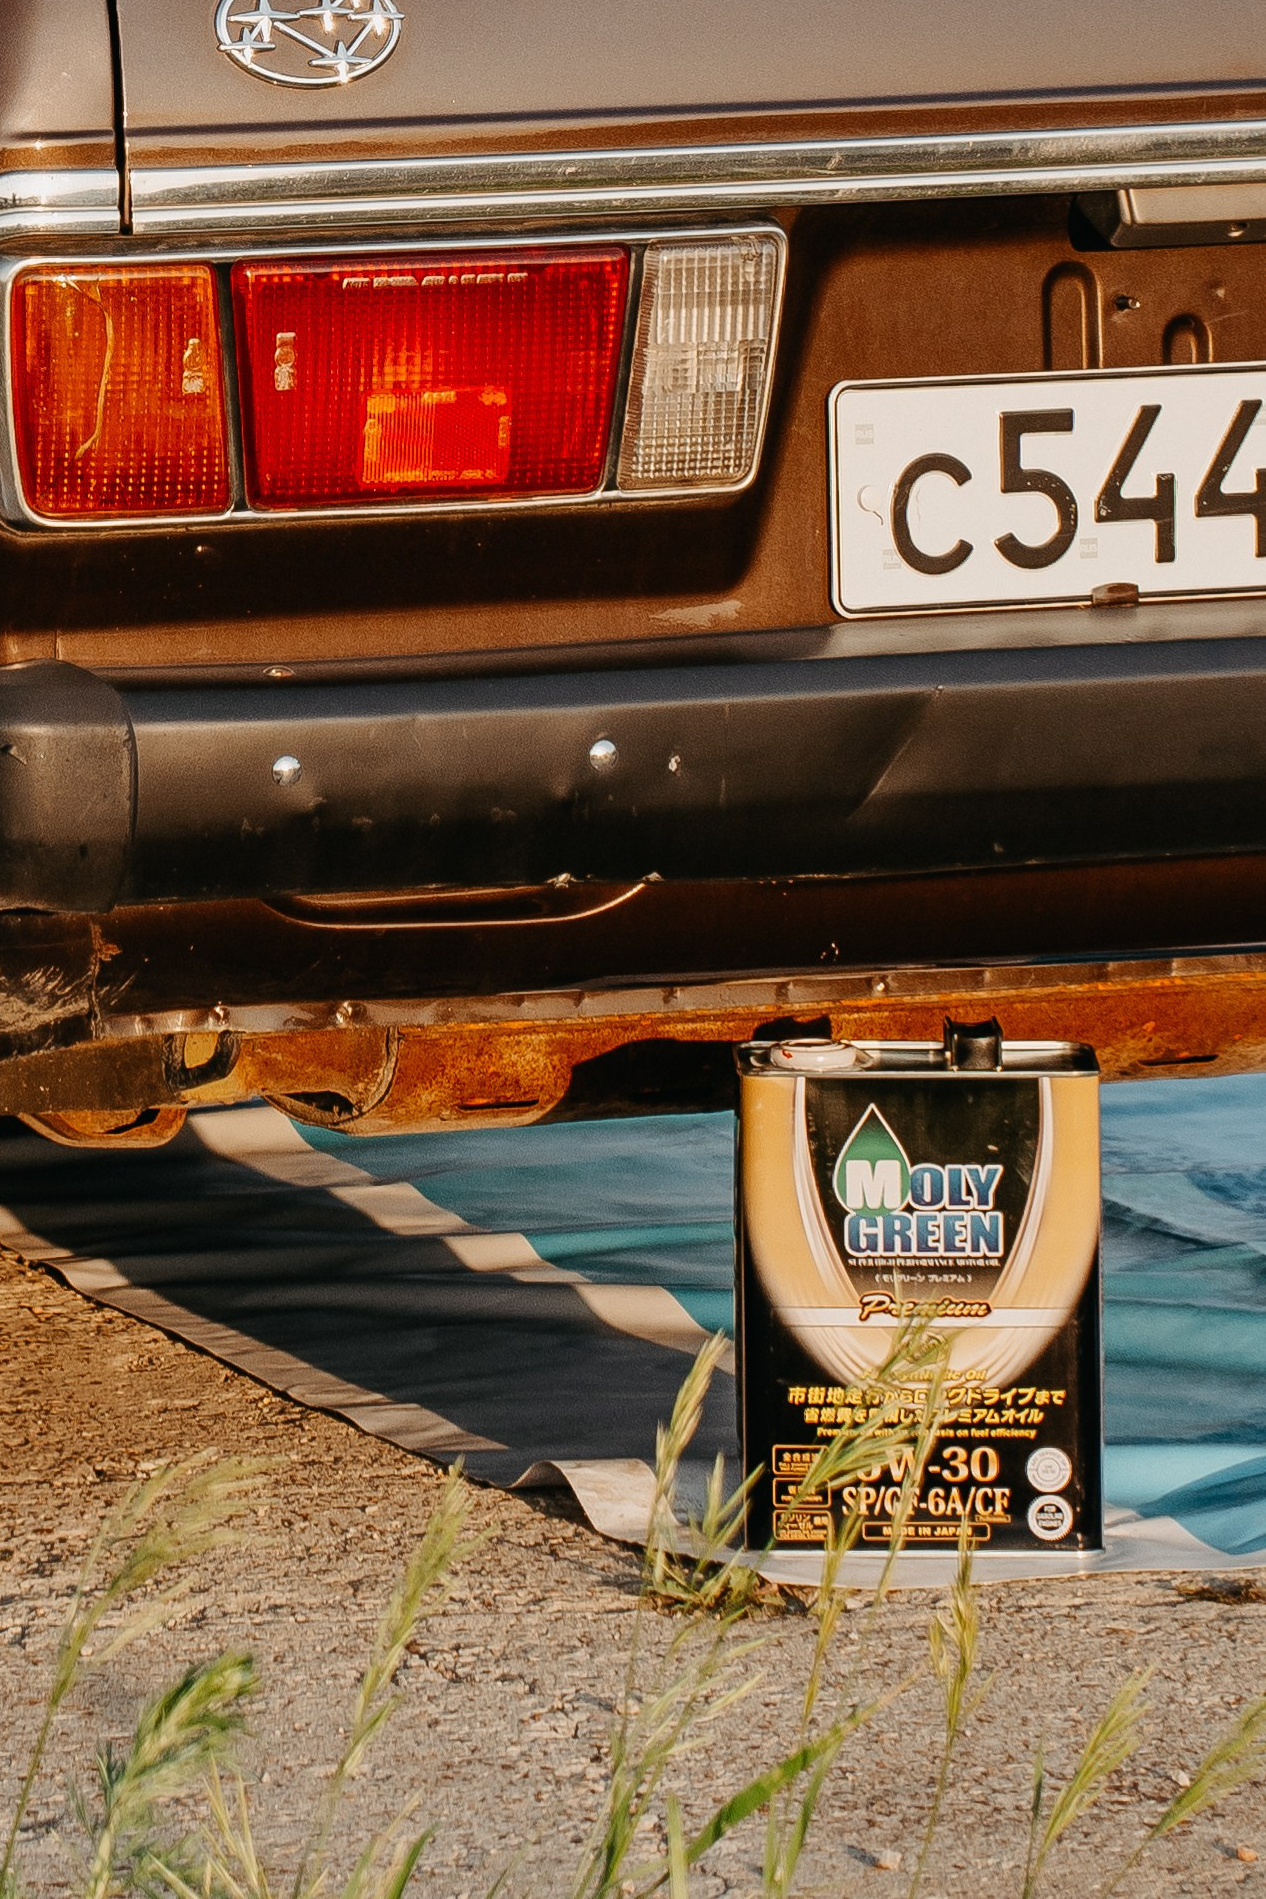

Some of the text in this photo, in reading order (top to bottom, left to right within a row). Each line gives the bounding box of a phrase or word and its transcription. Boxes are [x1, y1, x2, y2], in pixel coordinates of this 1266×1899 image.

[843, 1159, 1003, 1211] MOLY
[844, 1211, 1004, 1257] GREEN
[919, 1526, 931, 1537] IN
